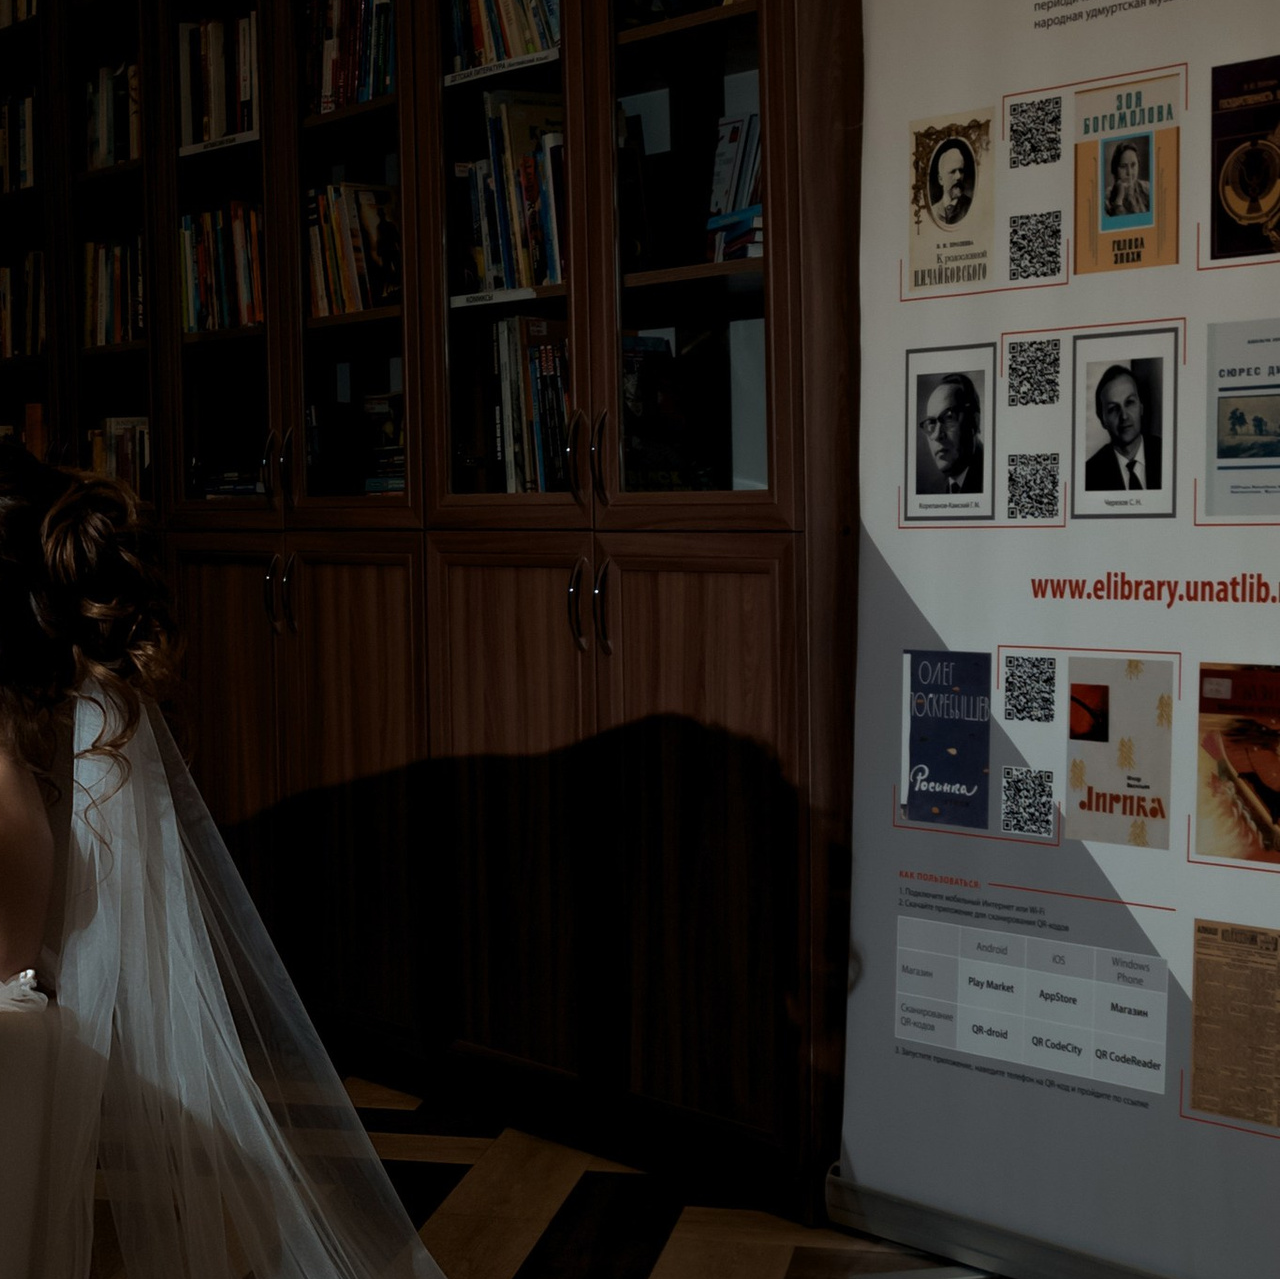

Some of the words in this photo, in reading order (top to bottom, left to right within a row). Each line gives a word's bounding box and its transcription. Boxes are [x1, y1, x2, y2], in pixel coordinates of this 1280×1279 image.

[1034, 11, 1083, 29] народная
[451, 72, 472, 83] ДЕТСКАЯ
[474, 63, 505, 76] ЛИТЕРАТУРА
[1116, 91, 1142, 111] ЗОЯ
[1083, 103, 1174, 135] БОГОМОЛОВА
[937, 254, 943, 263] К
[1219, 366, 1261, 378] СЮРЕС
[1031, 572, 1280, 608] www.elibrary.unatlib.
[918, 661, 956, 685] ОЛЕГ
[899, 871, 914, 879] КАК
[905, 899, 934, 911] Скачайте
[982, 900, 1014, 912] Интернет
[1029, 906, 1045, 915] Wi-Fi
[977, 942, 1008, 955] Android
[1052, 955, 1065, 965] iOS
[1112, 957, 1150, 972] Windows
[902, 965, 933, 977] Магазин
[1117, 972, 1144, 985] Phone
[968, 976, 984, 989] Play
[986, 980, 1014, 993] Market
[1039, 990, 1077, 1005] AppStore
[901, 1003, 953, 1022] Сканирование
[1111, 1002, 1148, 1017] Магазин
[901, 1016, 935, 1031] QR-кодов
[972, 1024, 1008, 1039] QR-droid
[1032, 1036, 1043, 1047] QR
[1045, 1039, 1082, 1056] CodeCity
[1095, 1049, 1108, 1060] QR
[1109, 1052, 1161, 1070] CodeReader
